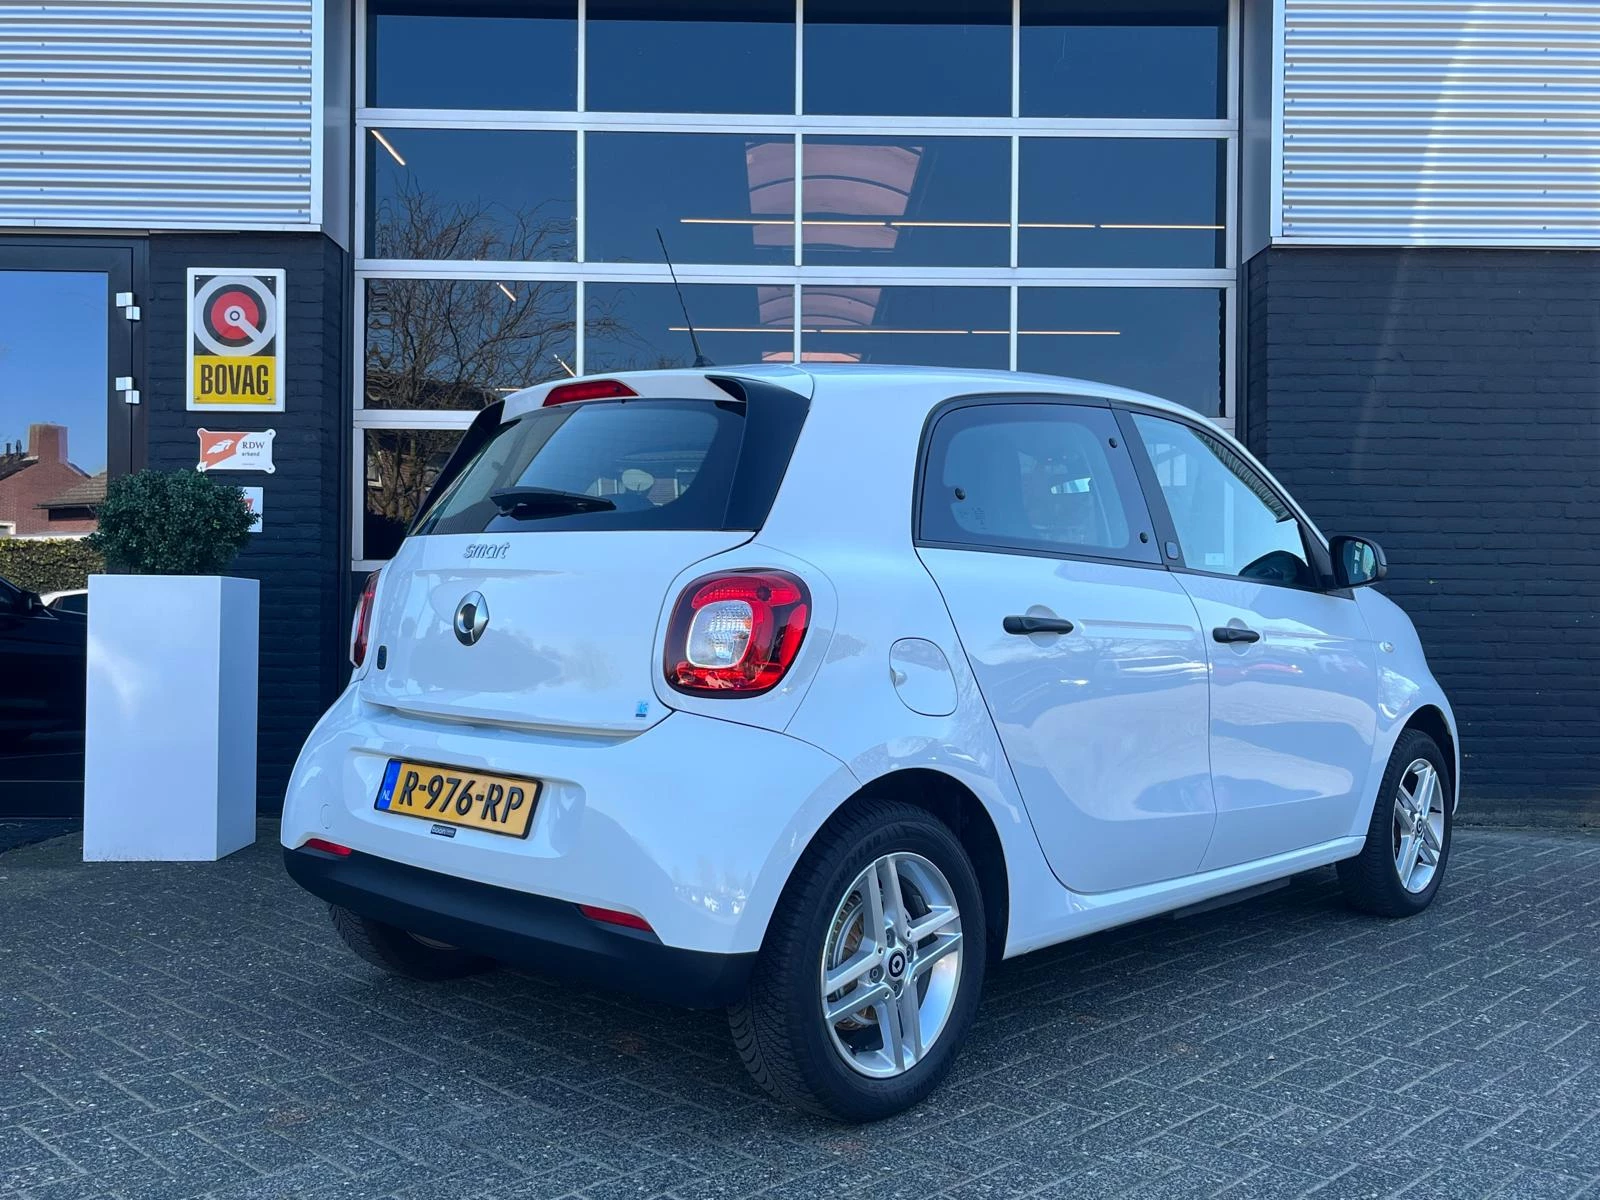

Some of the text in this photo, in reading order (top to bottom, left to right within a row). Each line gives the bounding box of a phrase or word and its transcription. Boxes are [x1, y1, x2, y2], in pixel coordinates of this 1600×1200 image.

[200, 364, 269, 396] BOVAG
[242, 441, 265, 450] RDW
[463, 542, 511, 560] smart
[381, 789, 391, 801] NL
[398, 770, 525, 824] R-976-RP
